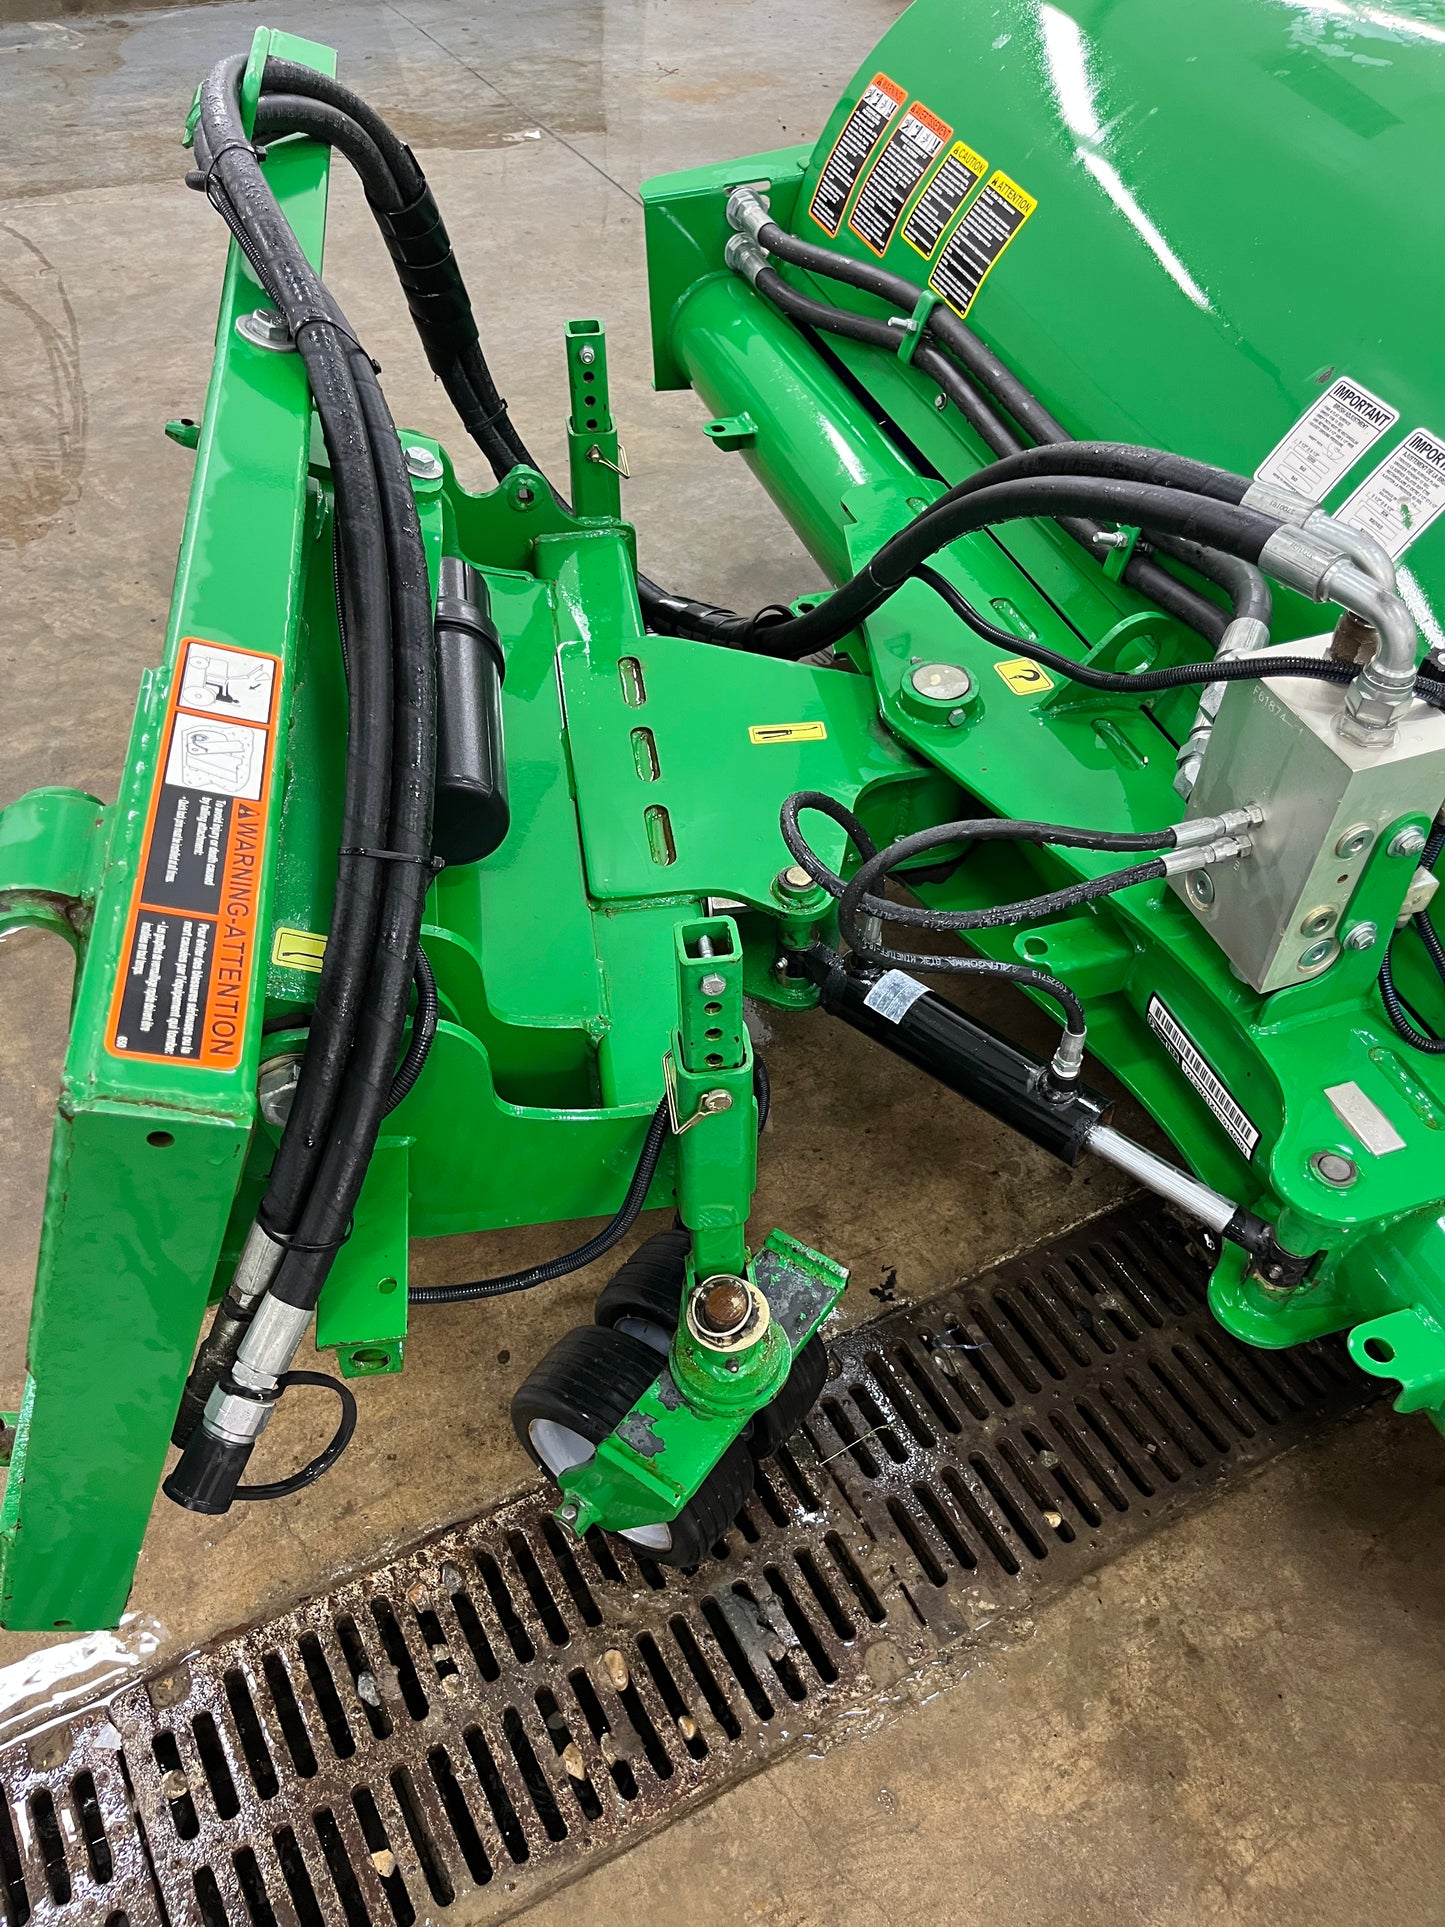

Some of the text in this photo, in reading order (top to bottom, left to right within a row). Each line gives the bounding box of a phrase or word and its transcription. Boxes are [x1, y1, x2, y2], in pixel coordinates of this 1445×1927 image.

[958, 147, 985, 174] CAUTION
[996, 181, 1032, 213] ATTENTION
[1333, 384, 1391, 427] IMPORTANT
[209, 823, 259, 1055] WARNING-ATTENTION
